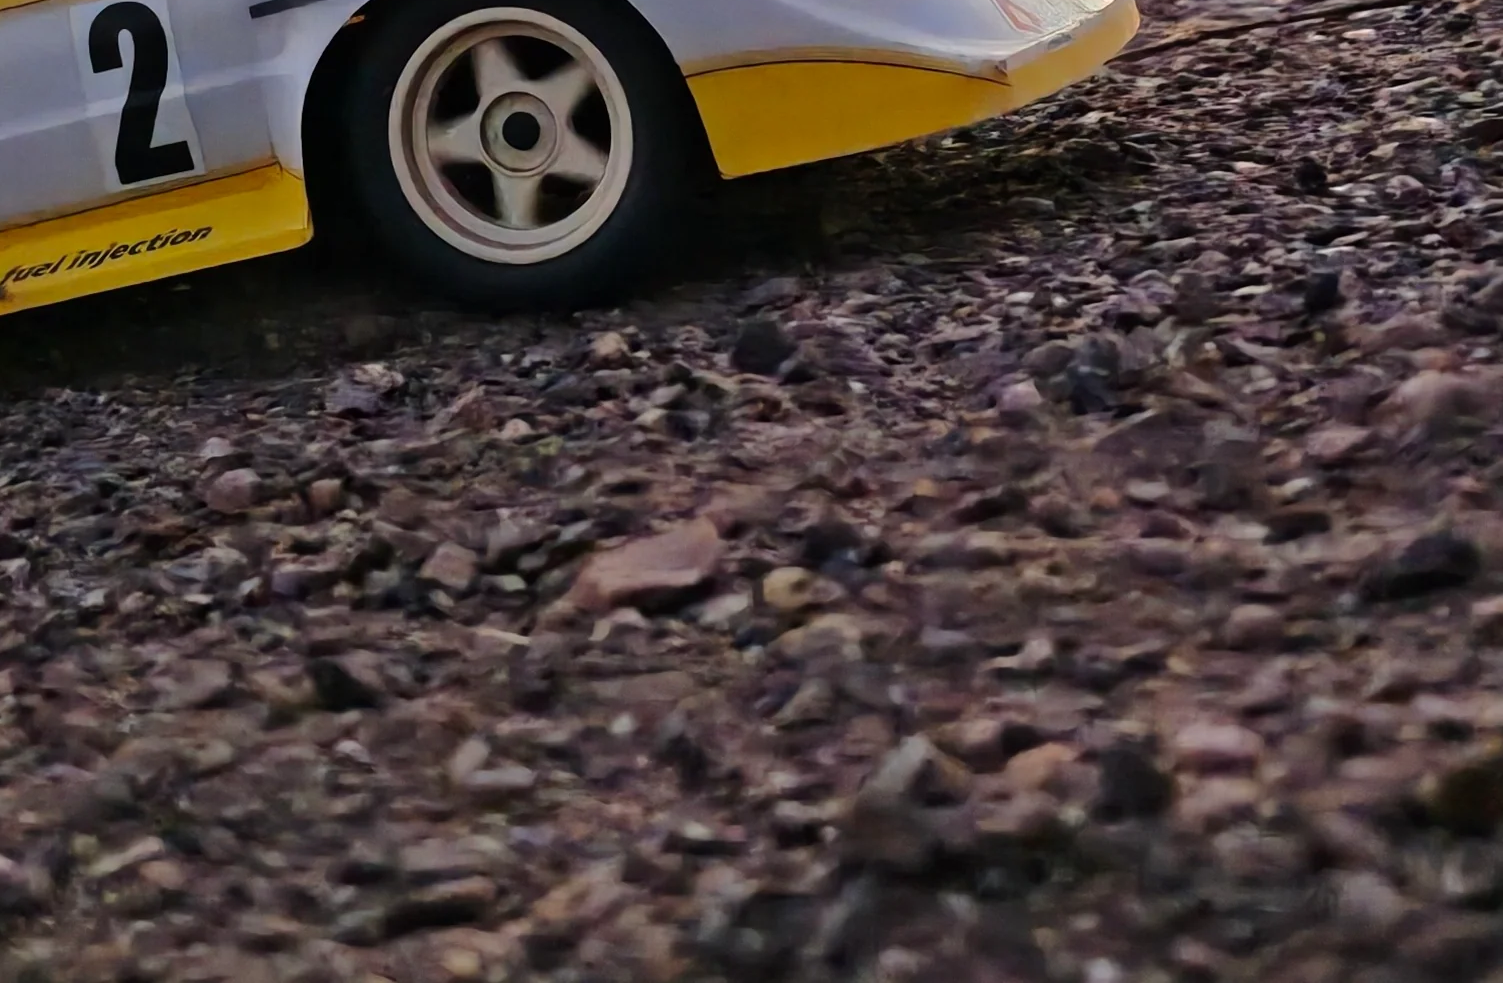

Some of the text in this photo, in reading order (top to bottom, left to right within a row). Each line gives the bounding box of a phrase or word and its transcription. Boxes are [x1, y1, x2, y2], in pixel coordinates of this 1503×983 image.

[88, 1, 194, 185] 2
[0, 225, 213, 286] fuel injection
